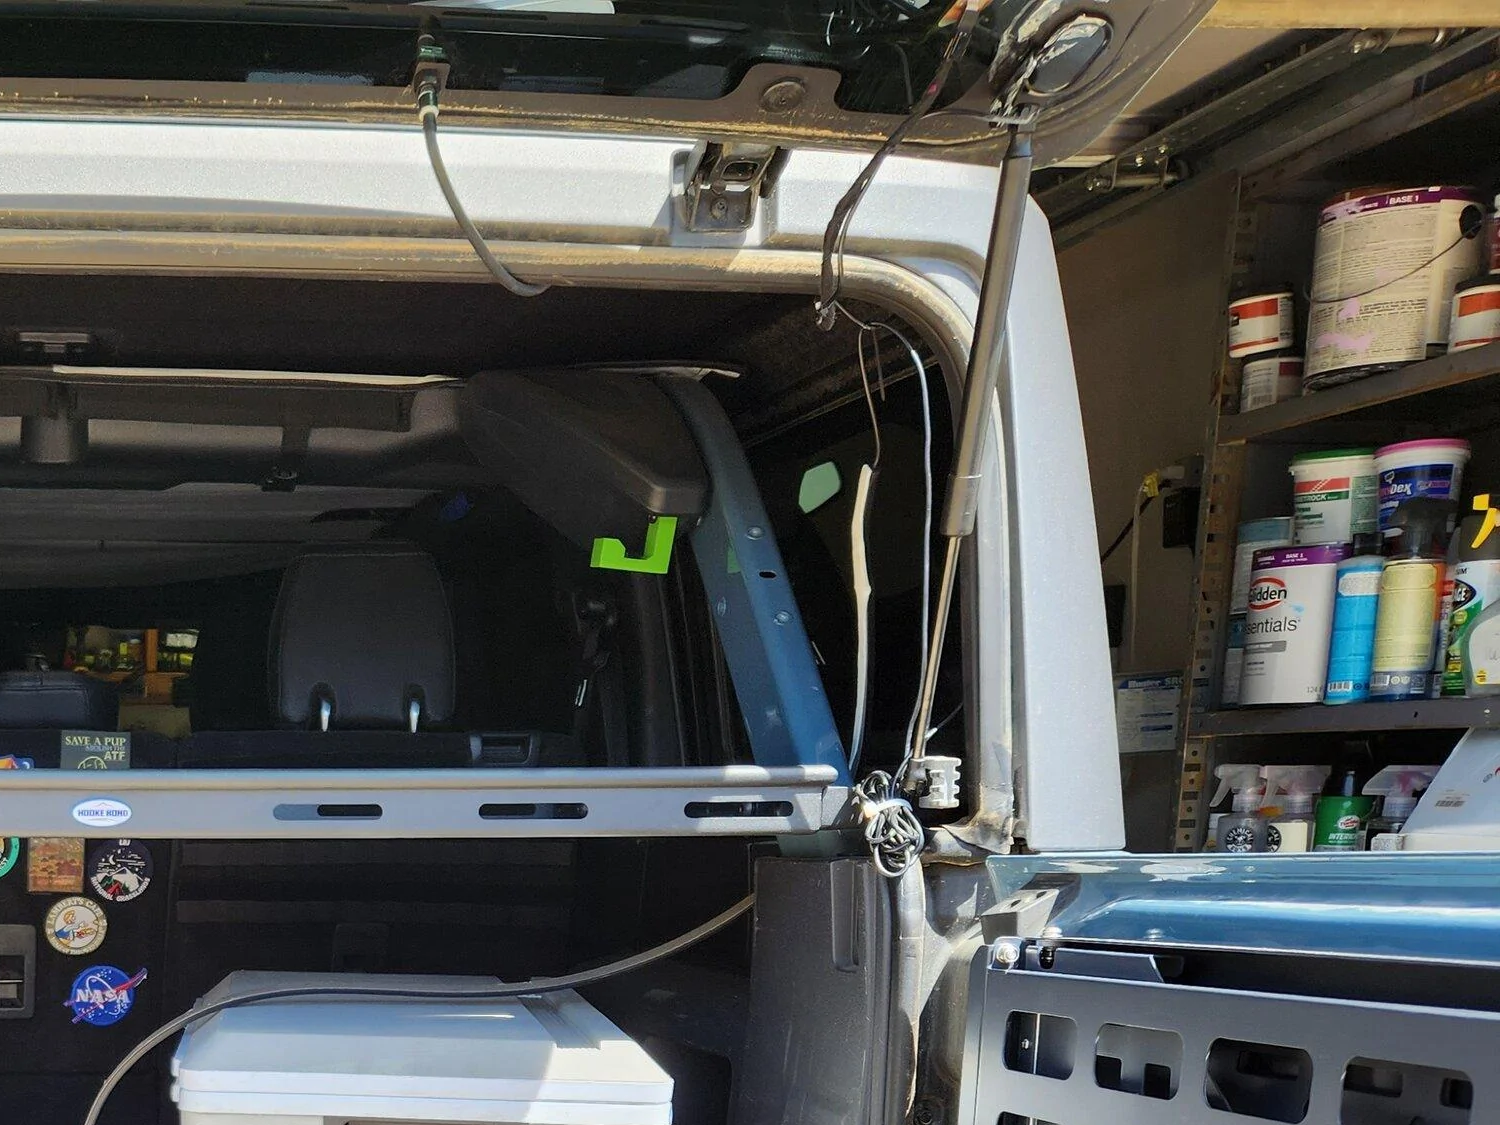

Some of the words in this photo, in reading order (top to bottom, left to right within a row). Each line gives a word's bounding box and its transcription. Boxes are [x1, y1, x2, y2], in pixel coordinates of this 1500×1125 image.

[1390, 195, 1413, 205] BASE
[1246, 617, 1298, 635] sentials
[65, 736, 90, 746] SAVE
[93, 736, 101, 746] A
[105, 737, 126, 747] PUP
[104, 751, 126, 761] ATF
[78, 809, 105, 817] HOOKE
[1227, 827, 1254, 842] CHEMICAL
[91, 876, 114, 901] NATIONAL
[75, 988, 131, 1003] NASA
